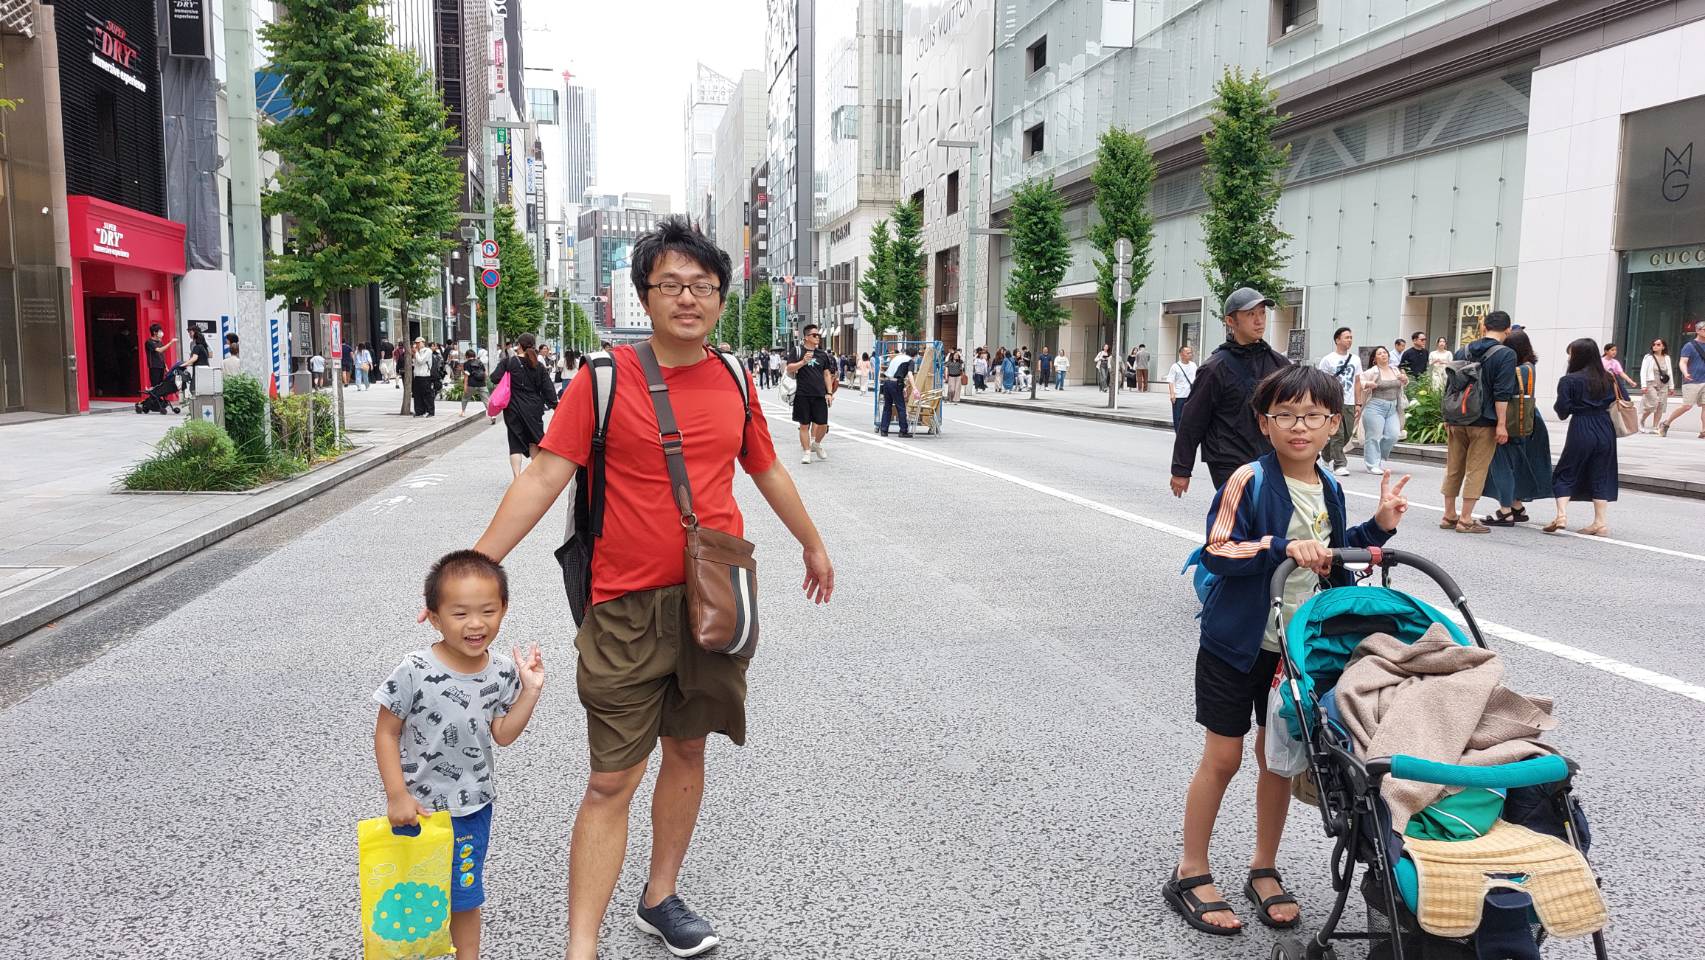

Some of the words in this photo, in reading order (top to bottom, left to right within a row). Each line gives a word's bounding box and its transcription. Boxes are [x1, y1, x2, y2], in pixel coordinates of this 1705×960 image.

[105, 20, 128, 39] SUPER
[915, 25, 936, 62] LOUIS
[120, 71, 147, 93] experience
[103, 222, 117, 231] SUPER
[1649, 249, 1705, 266] GUCC
[1461, 303, 1491, 318] LOEW
